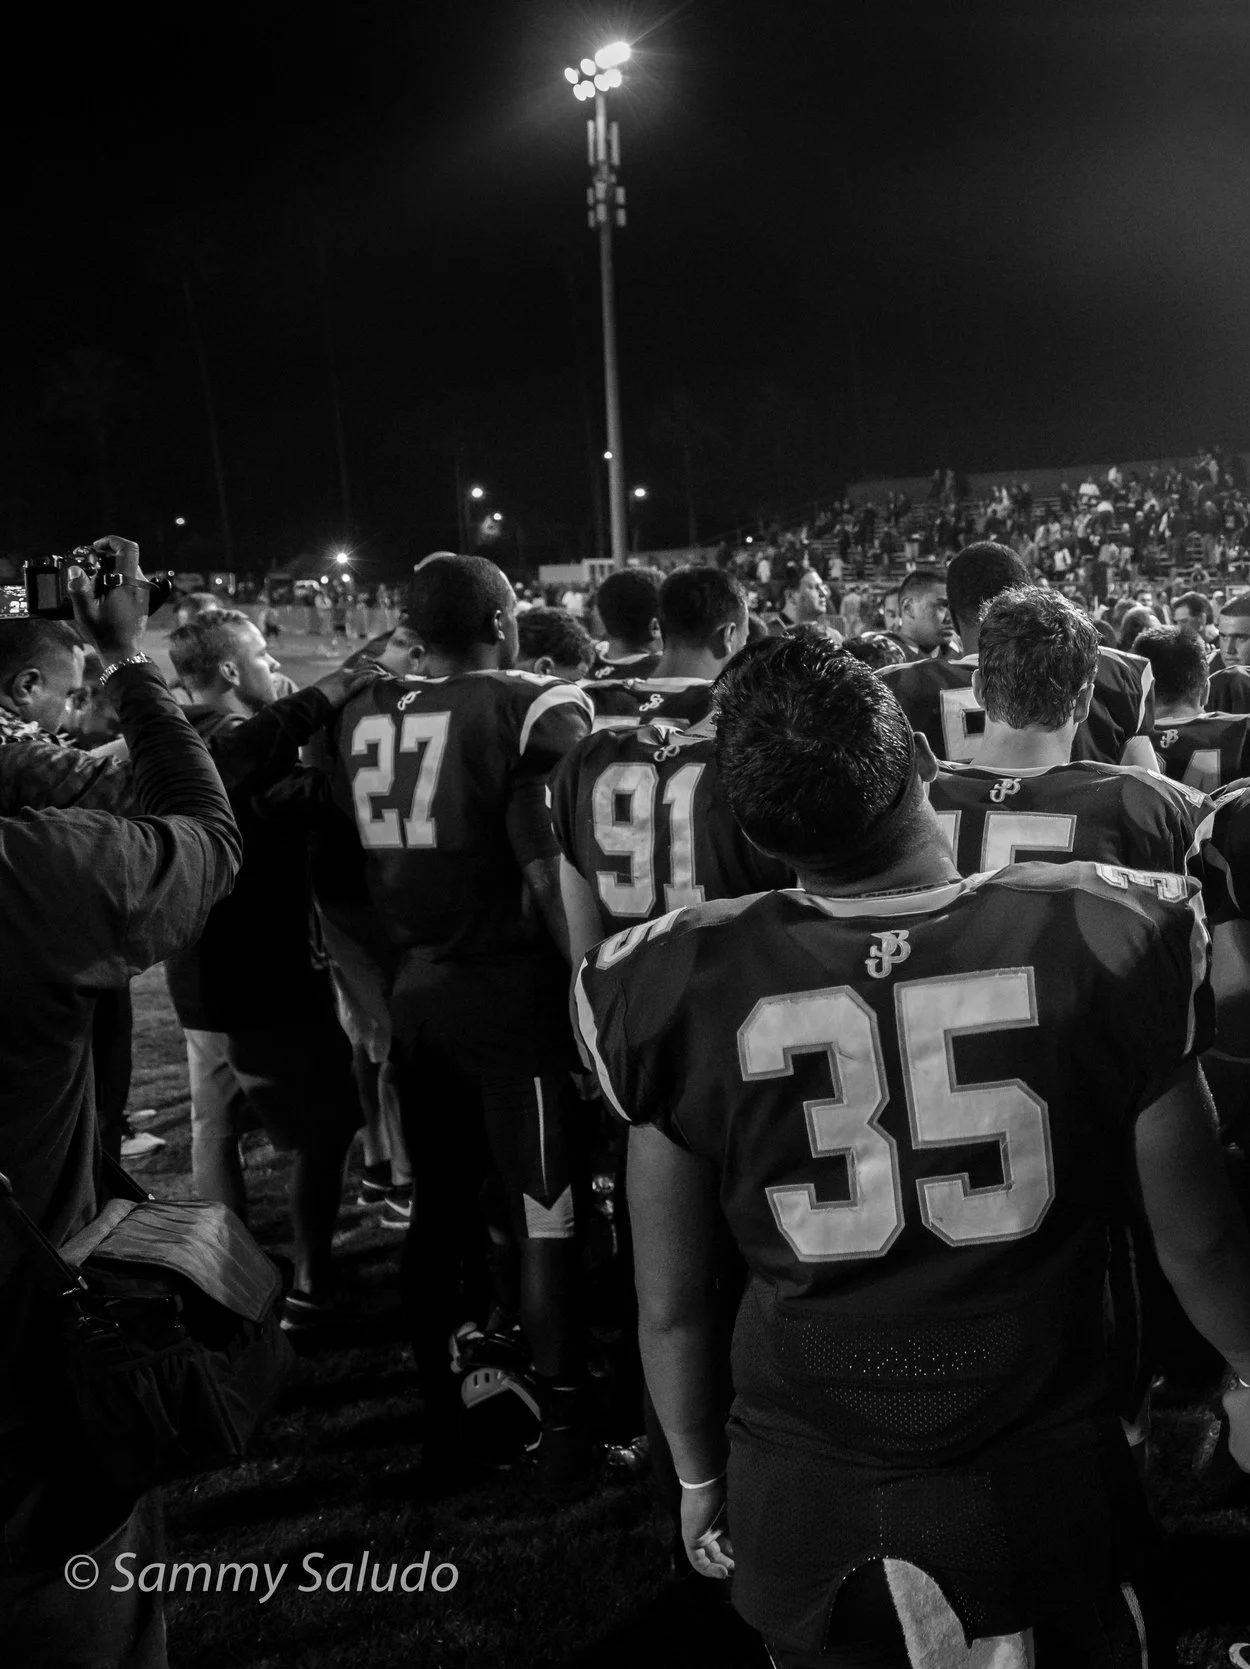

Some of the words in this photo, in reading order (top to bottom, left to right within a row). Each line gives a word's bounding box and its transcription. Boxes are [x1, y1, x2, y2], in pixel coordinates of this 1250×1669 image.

[351, 711, 452, 849] 27
[592, 762, 706, 918] 91
[737, 966, 1055, 1263] 35
